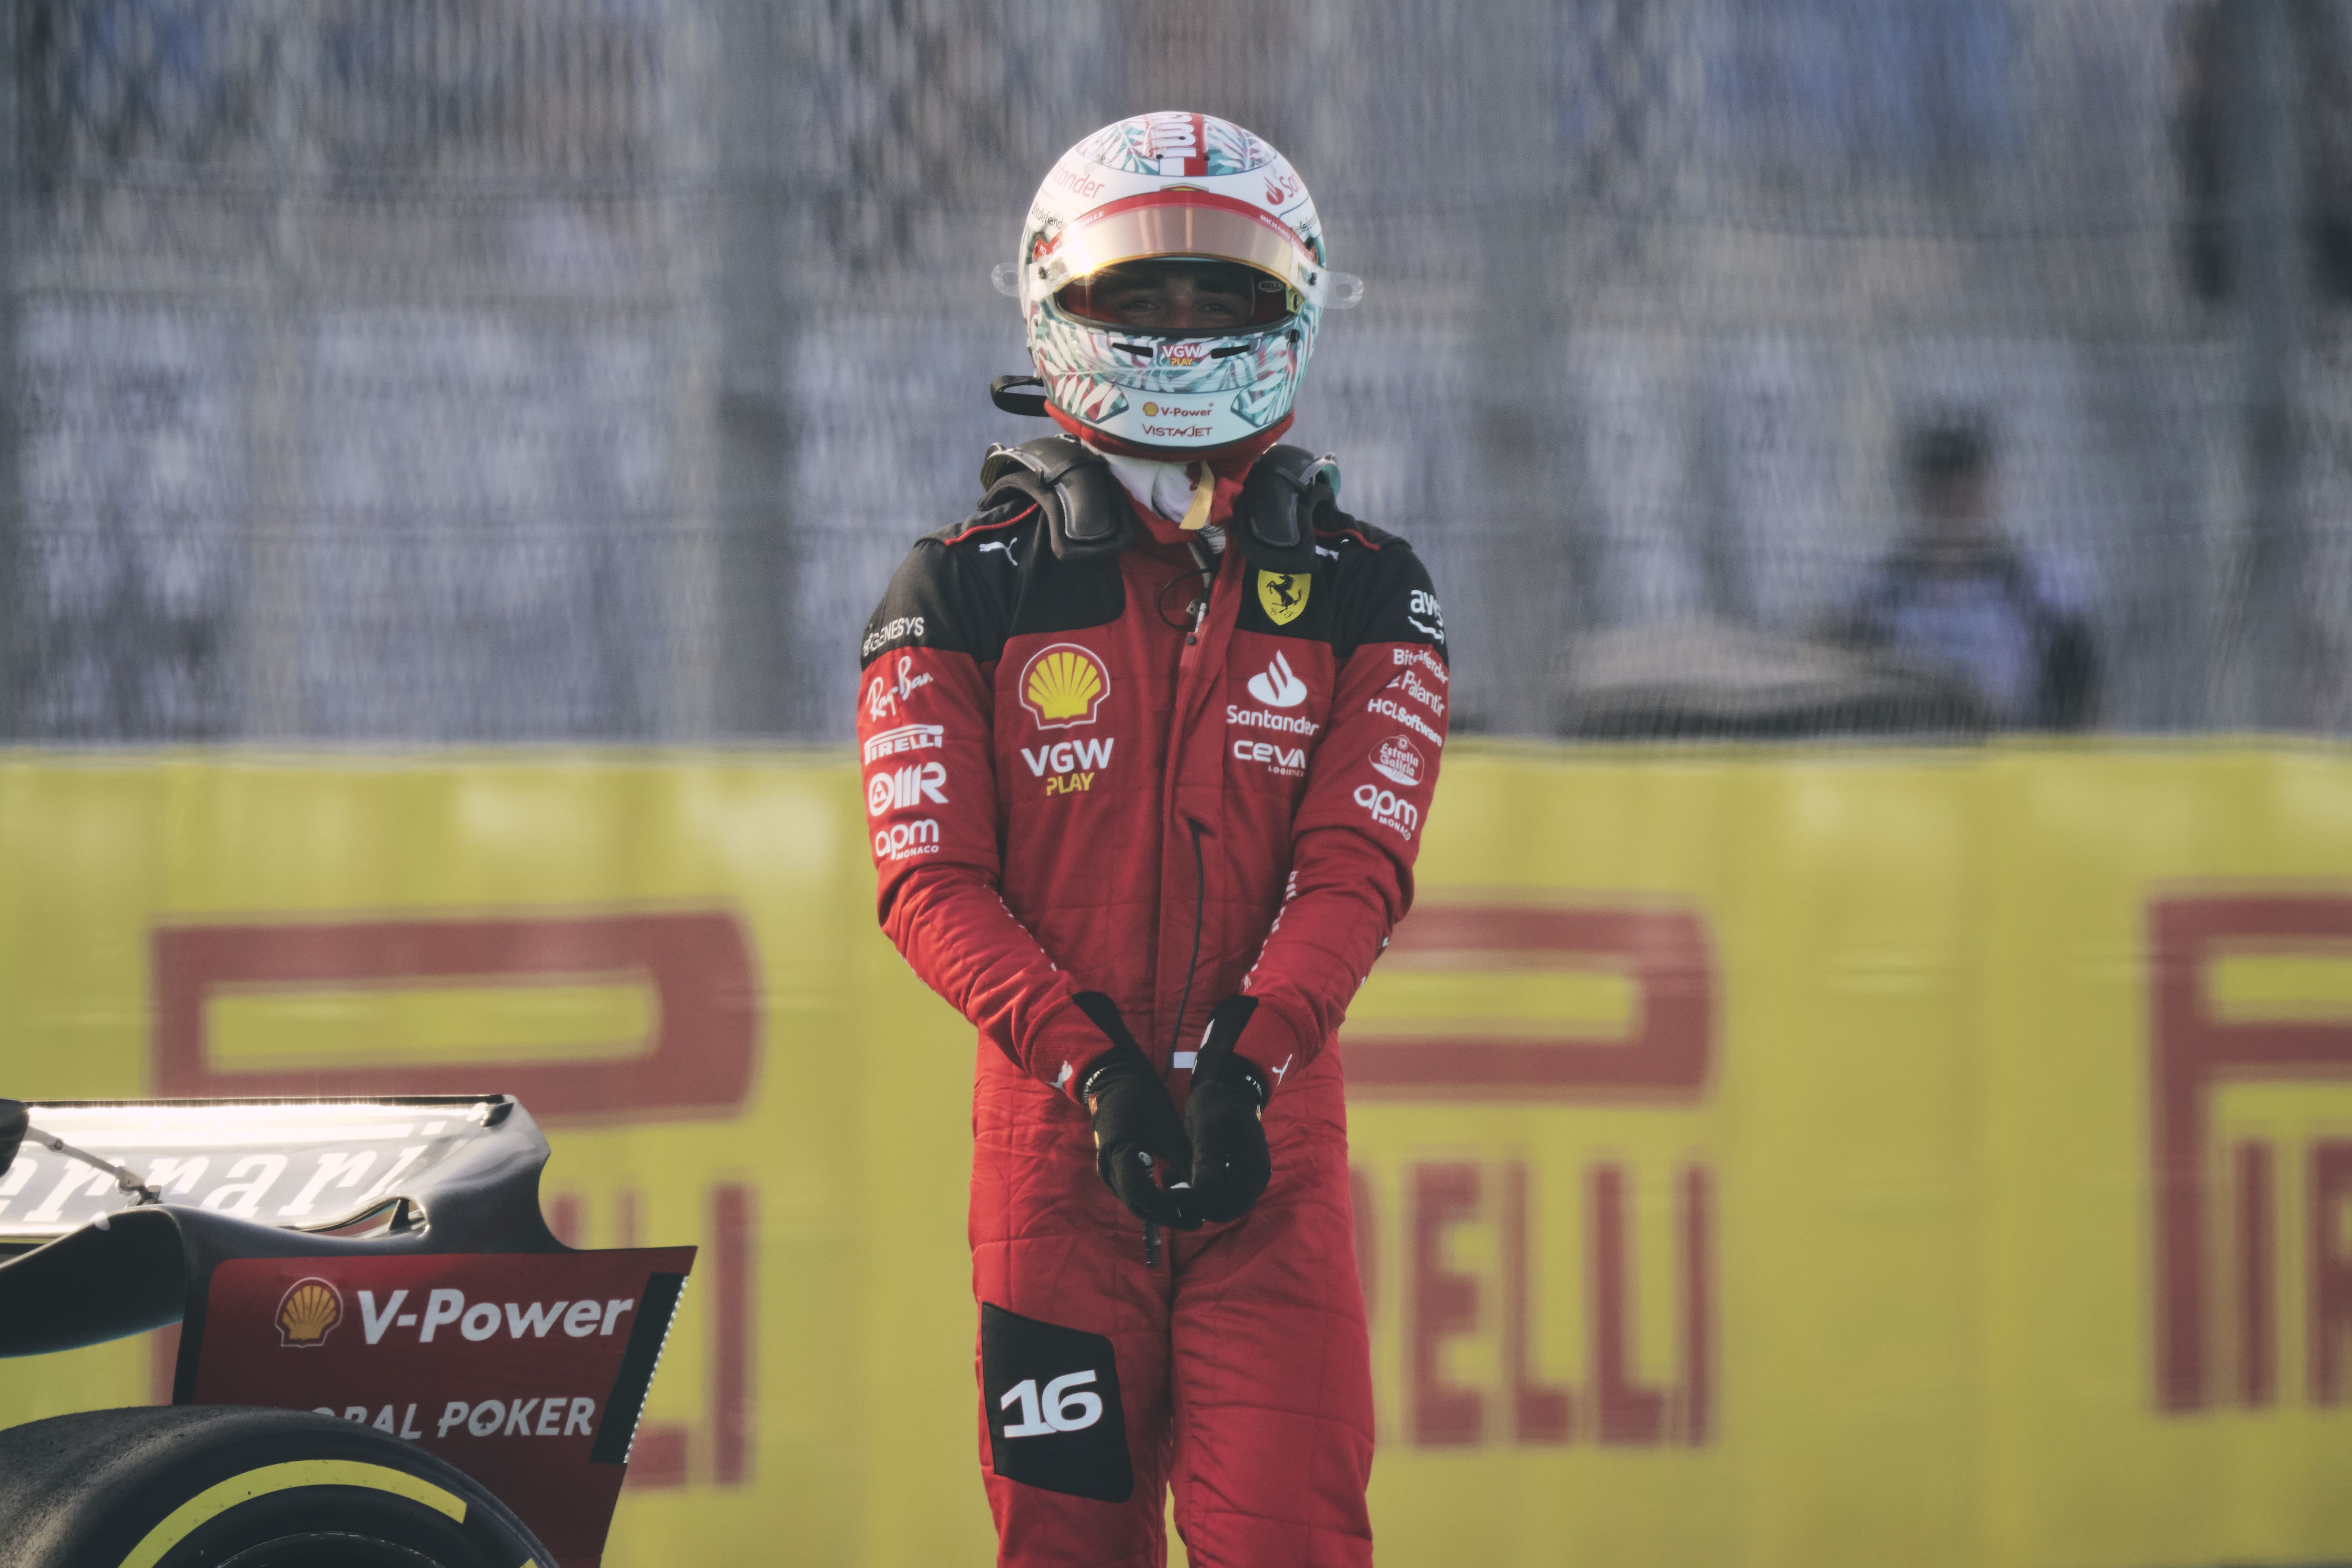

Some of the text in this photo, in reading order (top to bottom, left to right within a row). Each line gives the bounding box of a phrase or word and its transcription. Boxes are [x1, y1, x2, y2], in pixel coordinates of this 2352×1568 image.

[1162, 345, 1201, 358] VGW
[1161, 407, 1212, 417] V-Power
[869, 616, 924, 652] GENESYS
[1401, 670, 1445, 717] Palantir
[1227, 705, 1319, 736] Santander
[864, 724, 944, 766] PIRELLI
[1021, 737, 1114, 777] VGW
[1379, 742, 1419, 768] Estrella
[1046, 772, 1095, 796] PLAY
[1354, 784, 1418, 831] apm
[875, 818, 939, 860] apm
[1379, 816, 1411, 841] MONACO
[895, 845, 939, 860] MONACO
[357, 1288, 635, 1345] V-Power
[437, 1397, 595, 1438] POKER
[1000, 1369, 1103, 1439] 16
